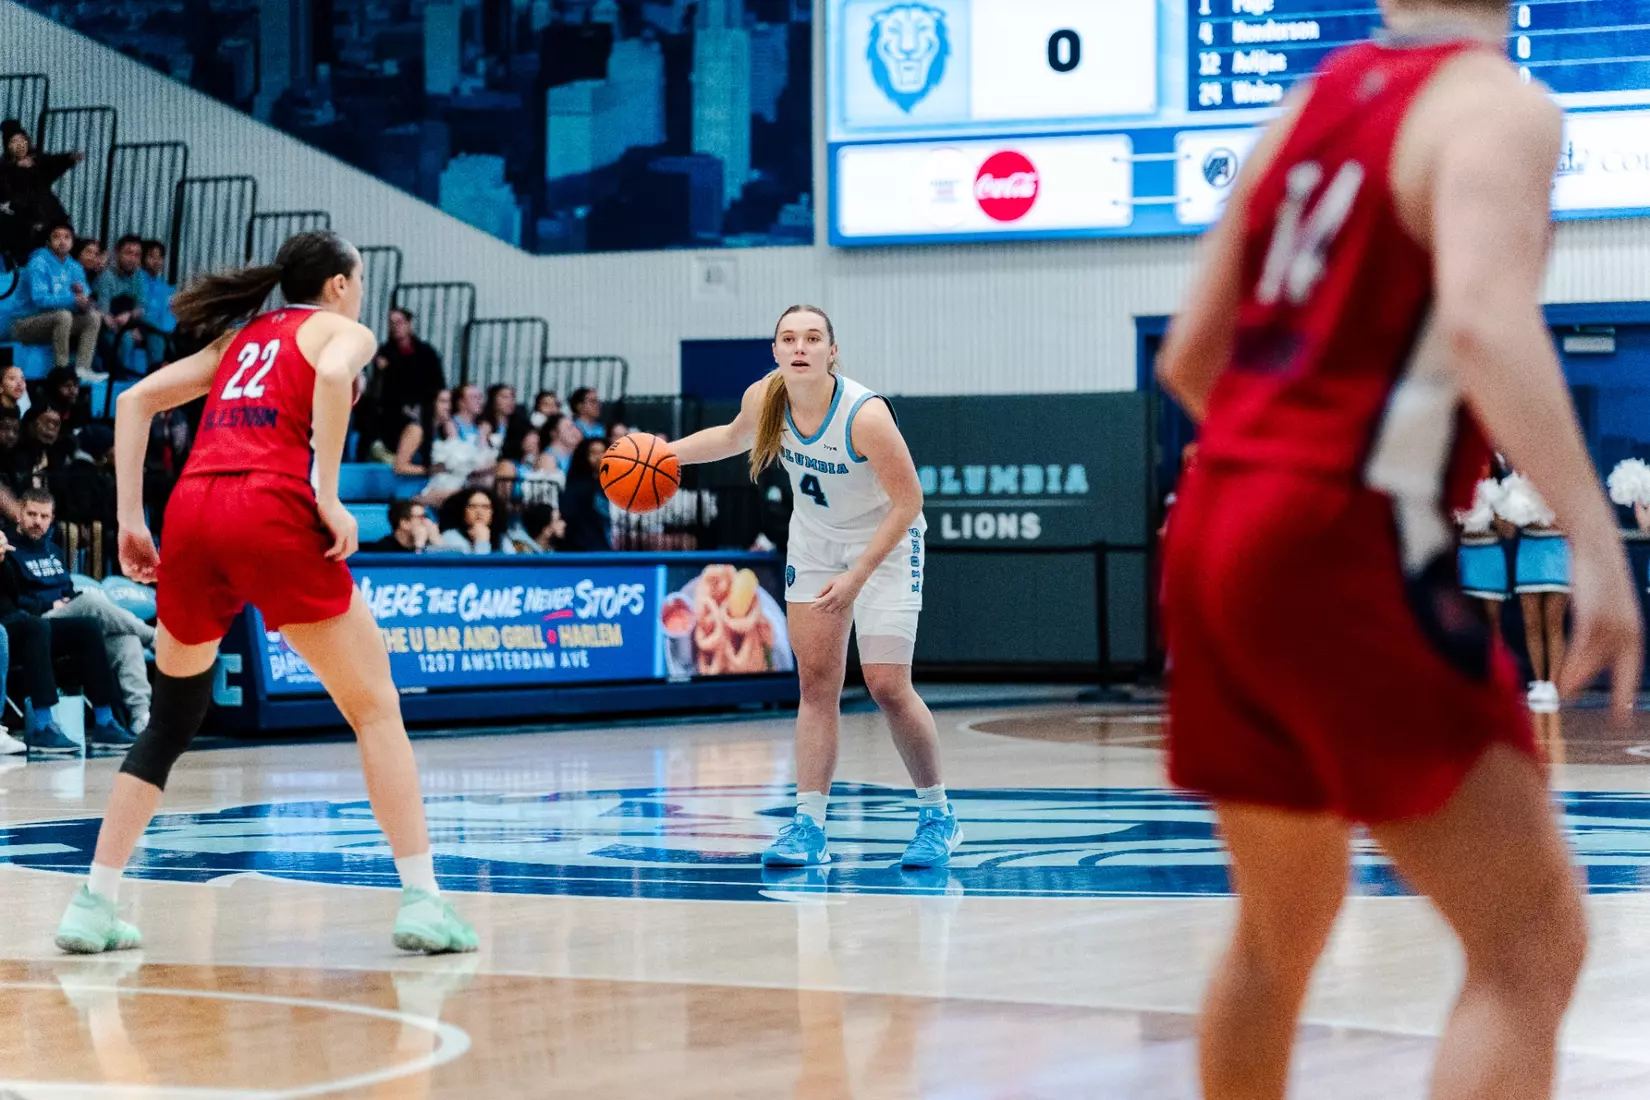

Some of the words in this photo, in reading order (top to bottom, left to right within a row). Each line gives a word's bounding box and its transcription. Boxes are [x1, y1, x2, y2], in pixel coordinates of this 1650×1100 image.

[1232, 19, 1320, 43] Henderson
[1517, 5, 1531, 28] 0
[1047, 28, 1081, 72] 0
[1517, 35, 1531, 59] 0
[220, 338, 281, 401] 22
[799, 472, 830, 509] 4
[919, 463, 1090, 495] OLUMBIA
[940, 511, 1042, 540] LIONS
[908, 528, 921, 593] LIONS
[426, 587, 459, 615] THE
[458, 582, 525, 623] GAME
[523, 586, 575, 613] NEVER
[575, 578, 645, 620] STOPS
[424, 625, 463, 652] BAR
[463, 624, 500, 651] AND
[500, 623, 548, 650] GRILL
[558, 622, 624, 649] HARLEM
[460, 650, 556, 672] AMSTERDAM
[559, 648, 591, 669] AVE
